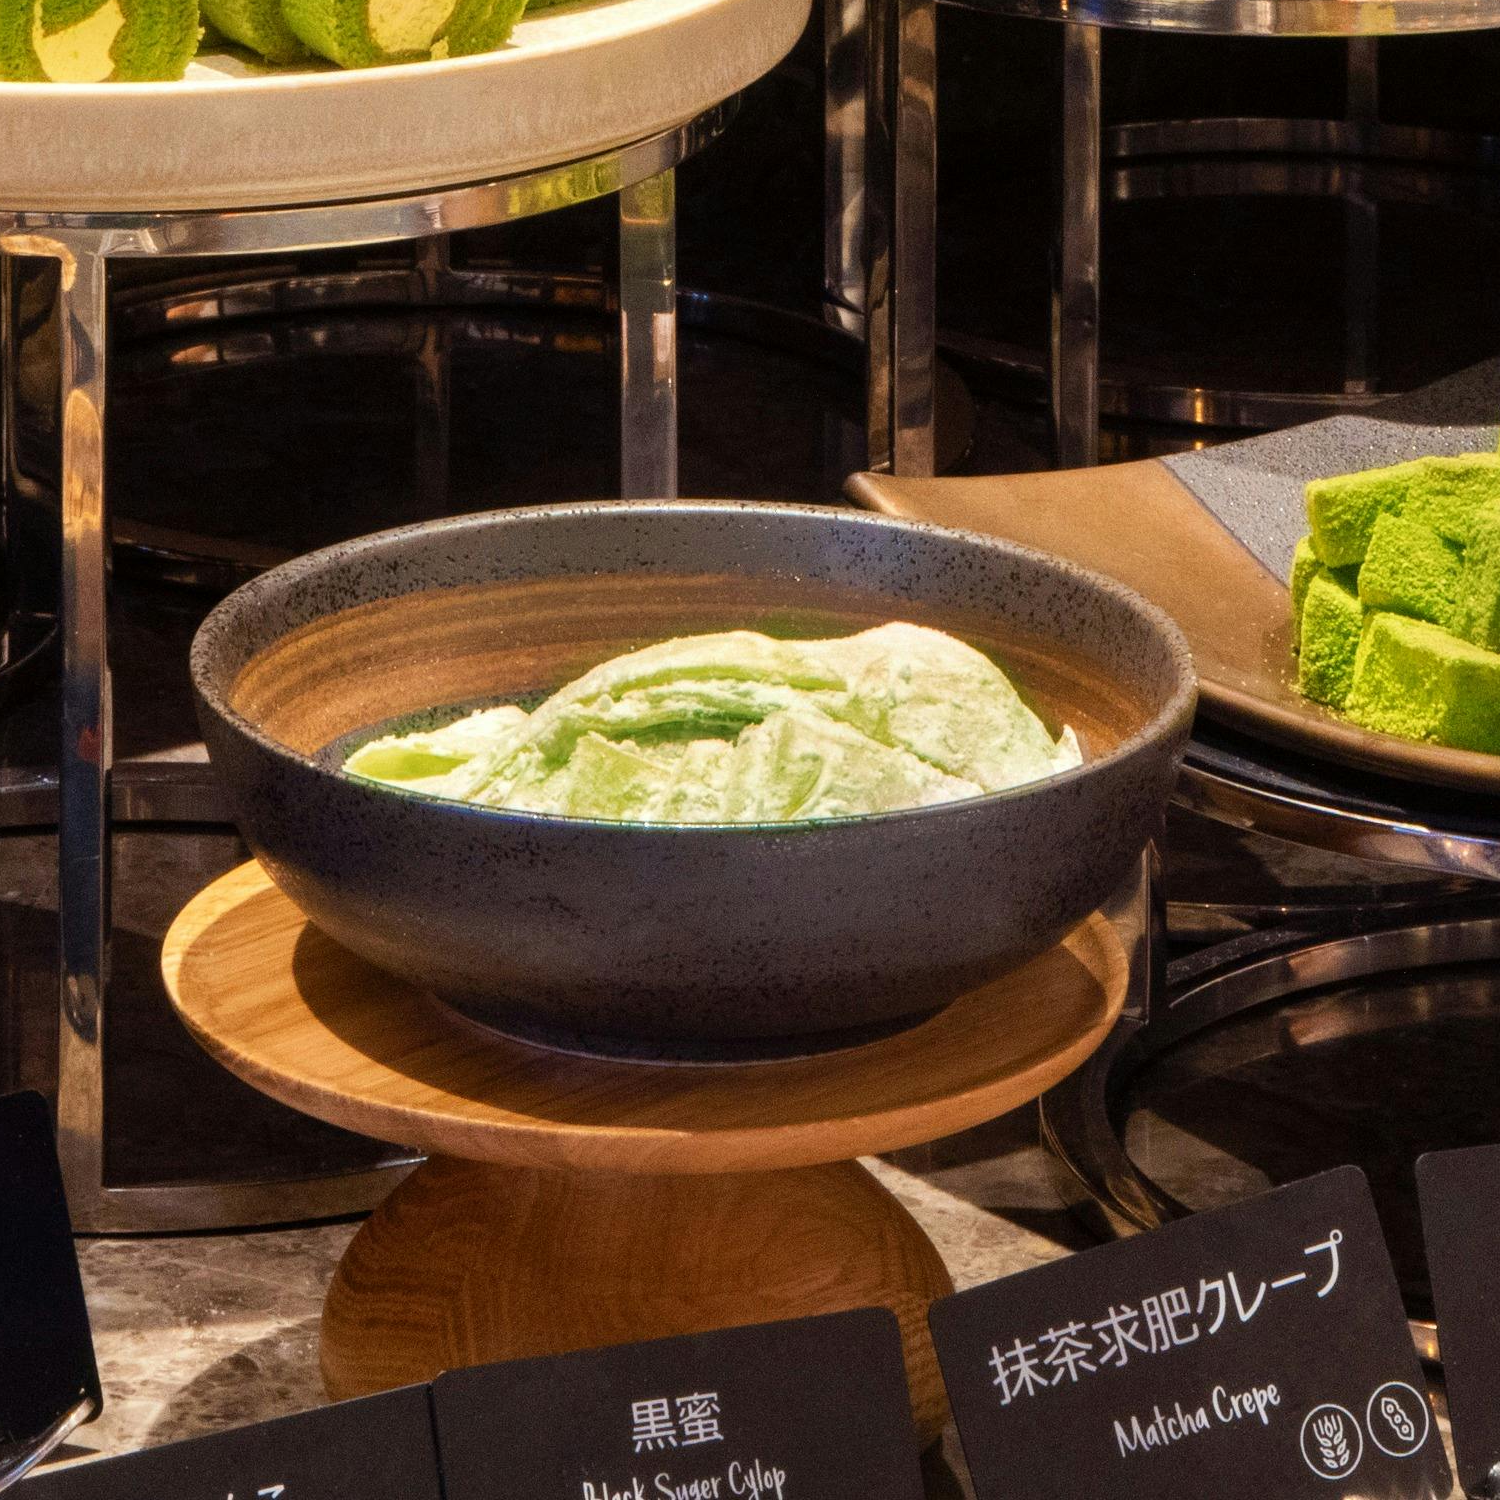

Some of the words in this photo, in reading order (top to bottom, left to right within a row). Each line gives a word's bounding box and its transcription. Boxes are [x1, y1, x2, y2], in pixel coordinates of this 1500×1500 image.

[988, 1228, 1343, 1405] 抹茶求肥クレープ
[631, 1392, 724, 1453] 黒蜜
[1113, 1402, 1211, 1458] Matcha
[1212, 1383, 1281, 1425] Crepe
